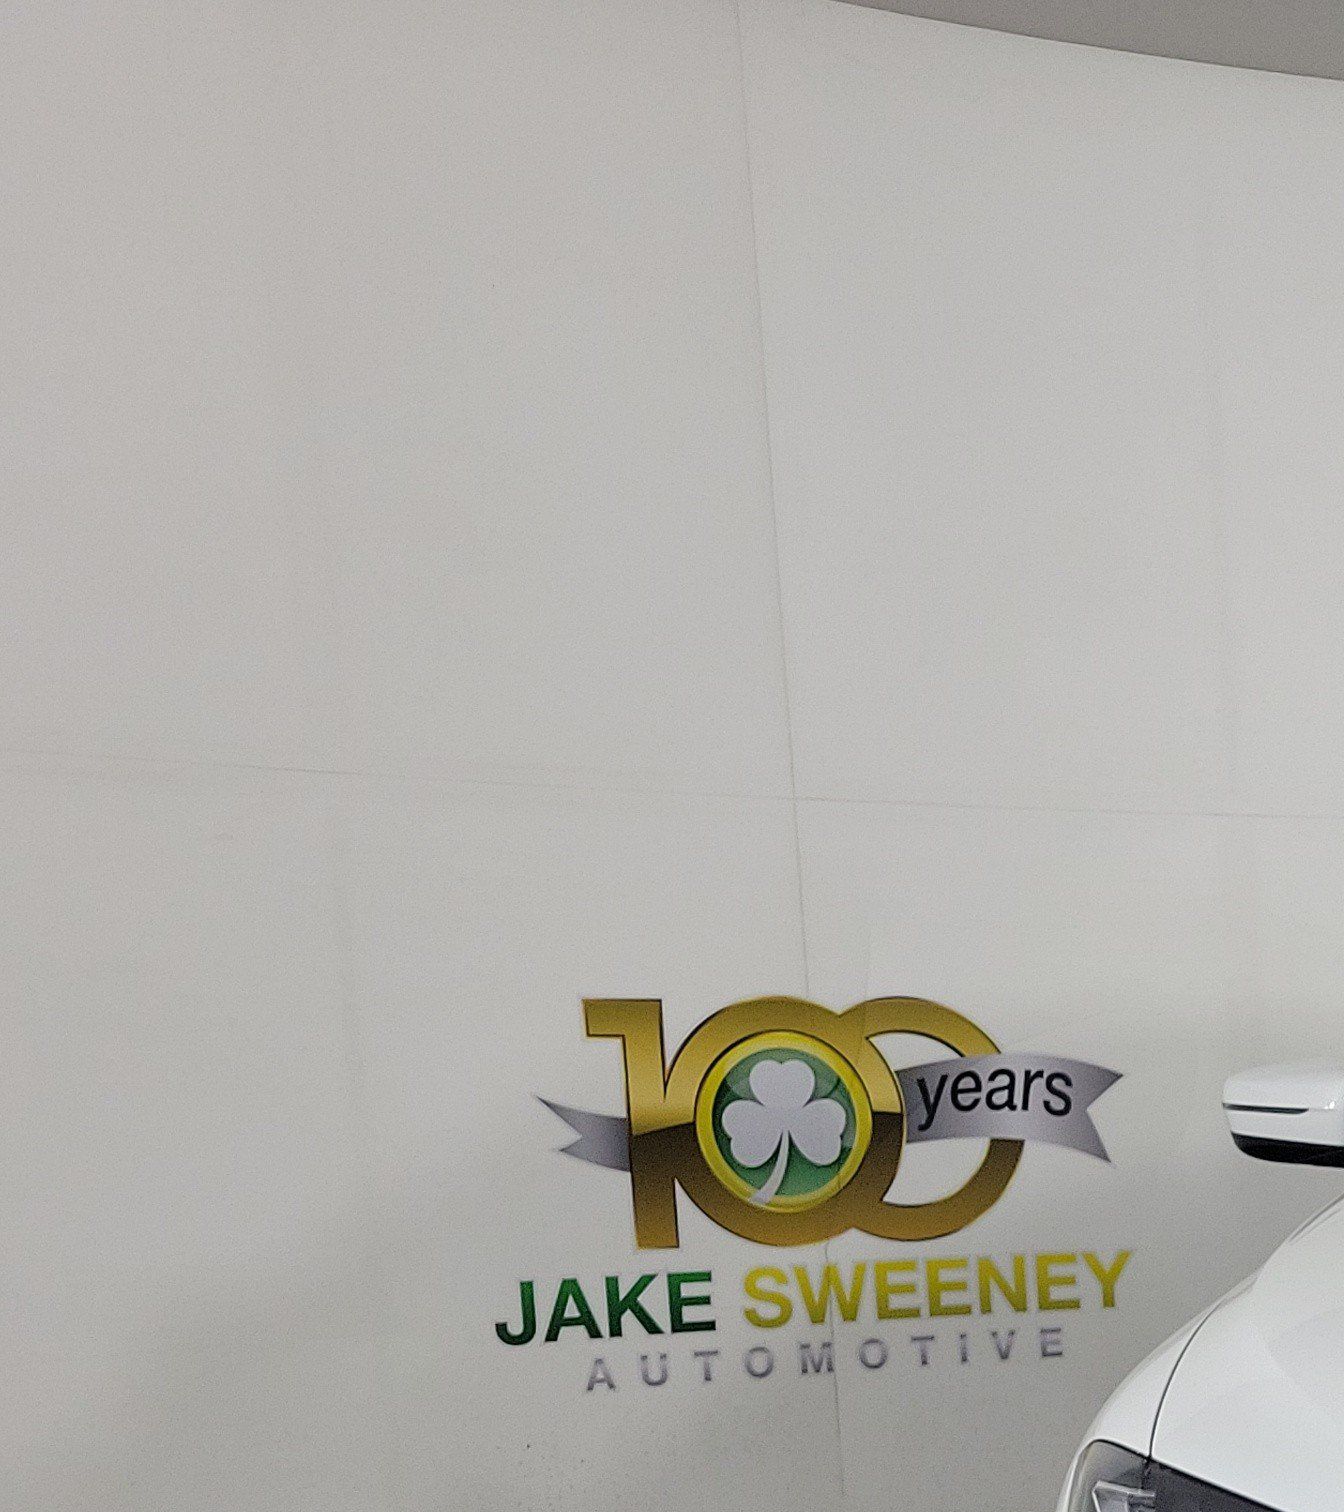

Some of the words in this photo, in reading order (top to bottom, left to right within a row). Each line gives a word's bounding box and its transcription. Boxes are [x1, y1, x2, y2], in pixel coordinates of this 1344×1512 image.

[582, 995, 1026, 1250] 100
[915, 1066, 1074, 1131] years
[494, 1269, 717, 1346] JAKE
[742, 1250, 1135, 1331] SWEENEY
[585, 1326, 1064, 1394] AUTOMOTIVE
